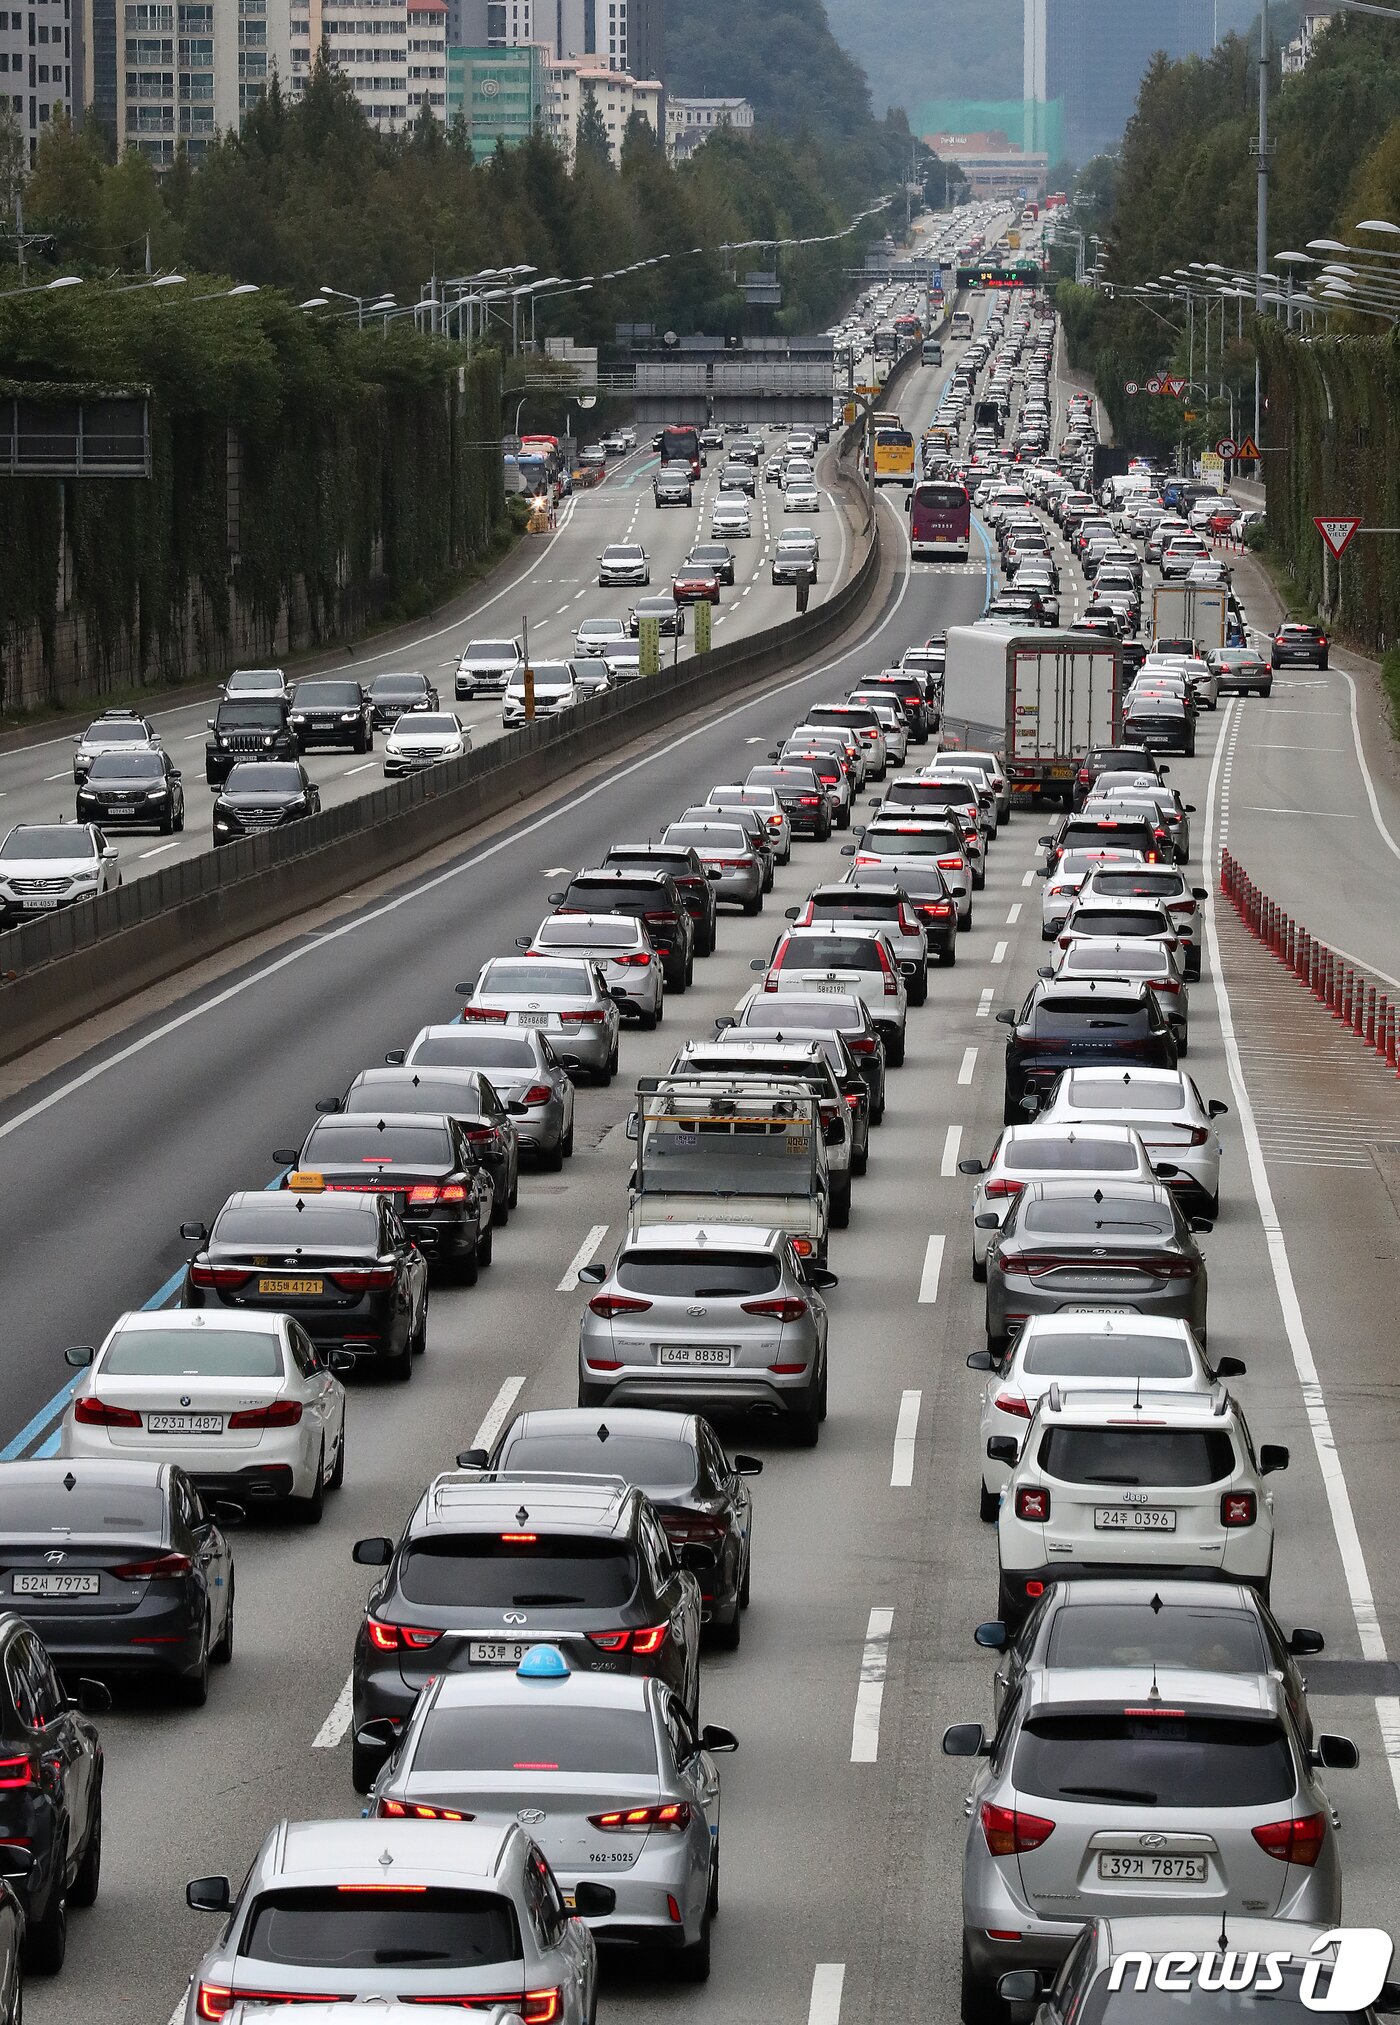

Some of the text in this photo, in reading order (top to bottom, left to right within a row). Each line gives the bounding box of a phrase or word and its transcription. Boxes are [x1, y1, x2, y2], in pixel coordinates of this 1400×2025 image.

[1326, 523, 1349, 532] 양보
[292, 1281, 318, 1292] 4121
[668, 1350, 724, 1361] 64라 8838
[187, 1417, 218, 1429] 1487
[1123, 1492, 1148, 1503] Jeep
[1102, 1511, 1169, 1526] 24주 0396
[21, 1577, 91, 1590] 52서 7973
[478, 1645, 506, 1659] 53루
[589, 1853, 634, 1862] 962-5025
[1110, 1858, 1196, 1876] 39거 7875
